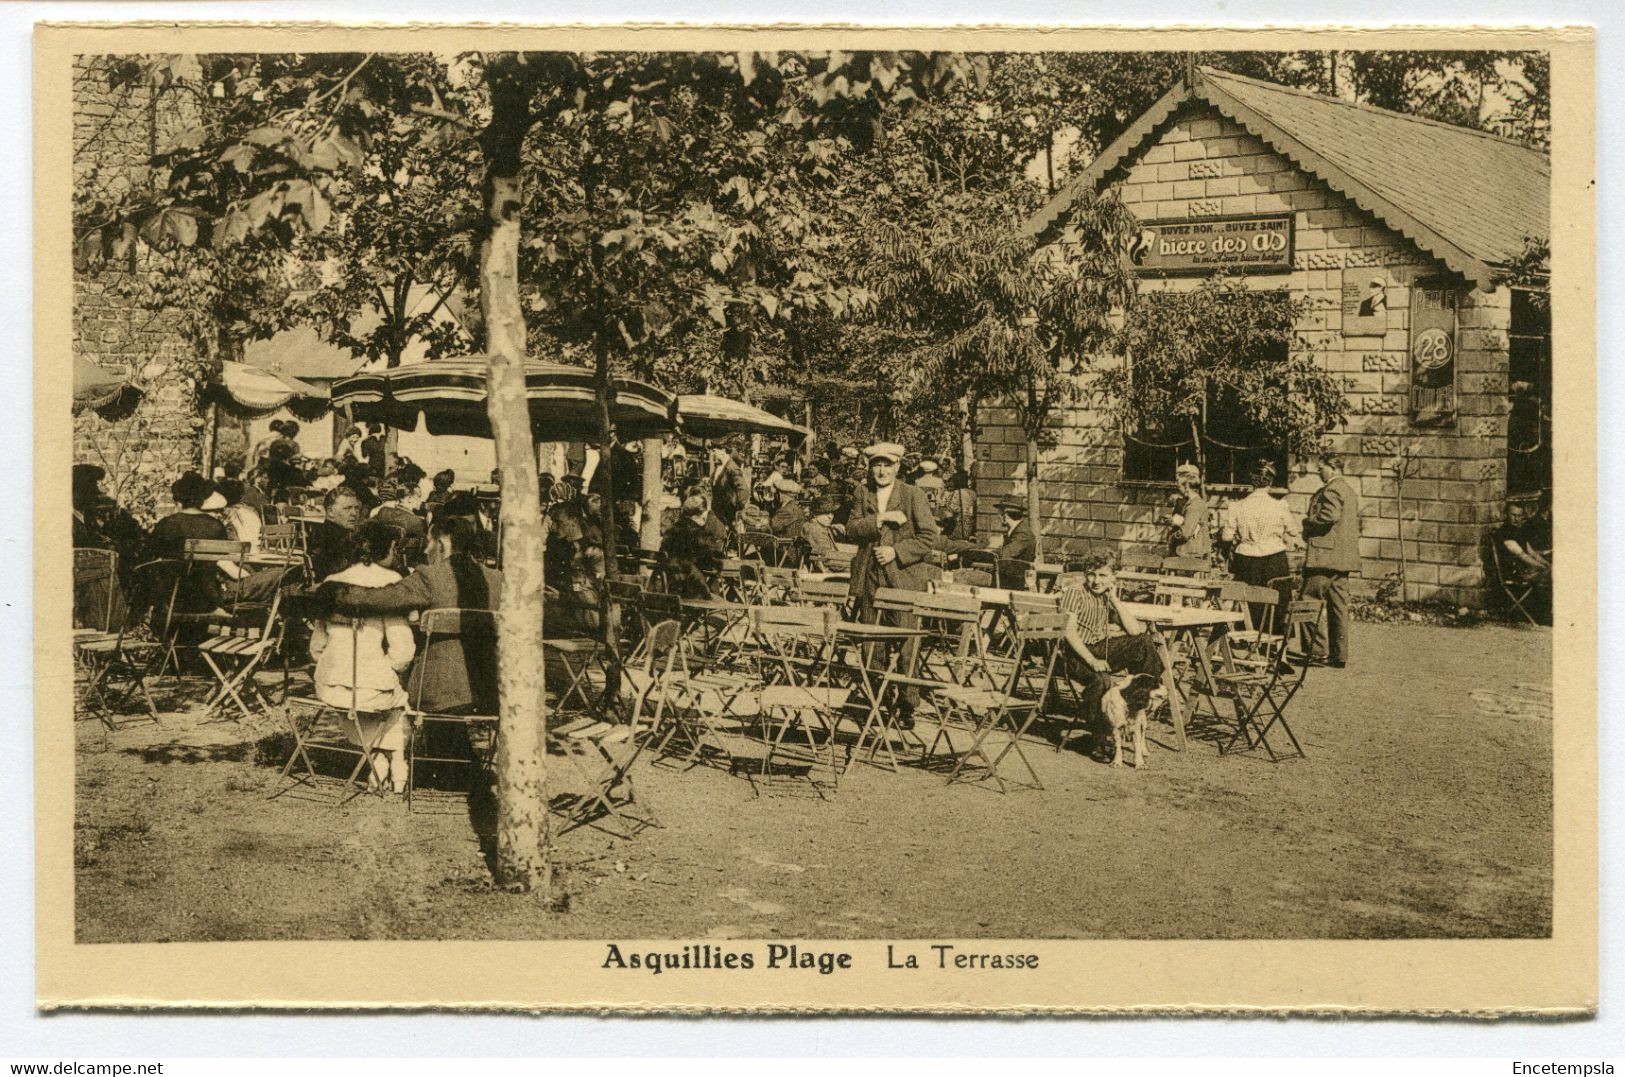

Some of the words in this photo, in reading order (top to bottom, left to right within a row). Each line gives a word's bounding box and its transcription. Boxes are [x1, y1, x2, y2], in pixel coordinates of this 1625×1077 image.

[1160, 226, 1190, 235] BUVEZ
[1159, 237, 1207, 256] bière
[1211, 235, 1247, 253] des
[1252, 231, 1286, 251] as
[1413, 289, 1455, 314] PERLE
[1421, 335, 1448, 362] 28
[601, 943, 755, 974] Asquillies
[766, 943, 853, 974] Plage
[886, 945, 920, 969] La
[931, 945, 1040, 969] Terrasse
